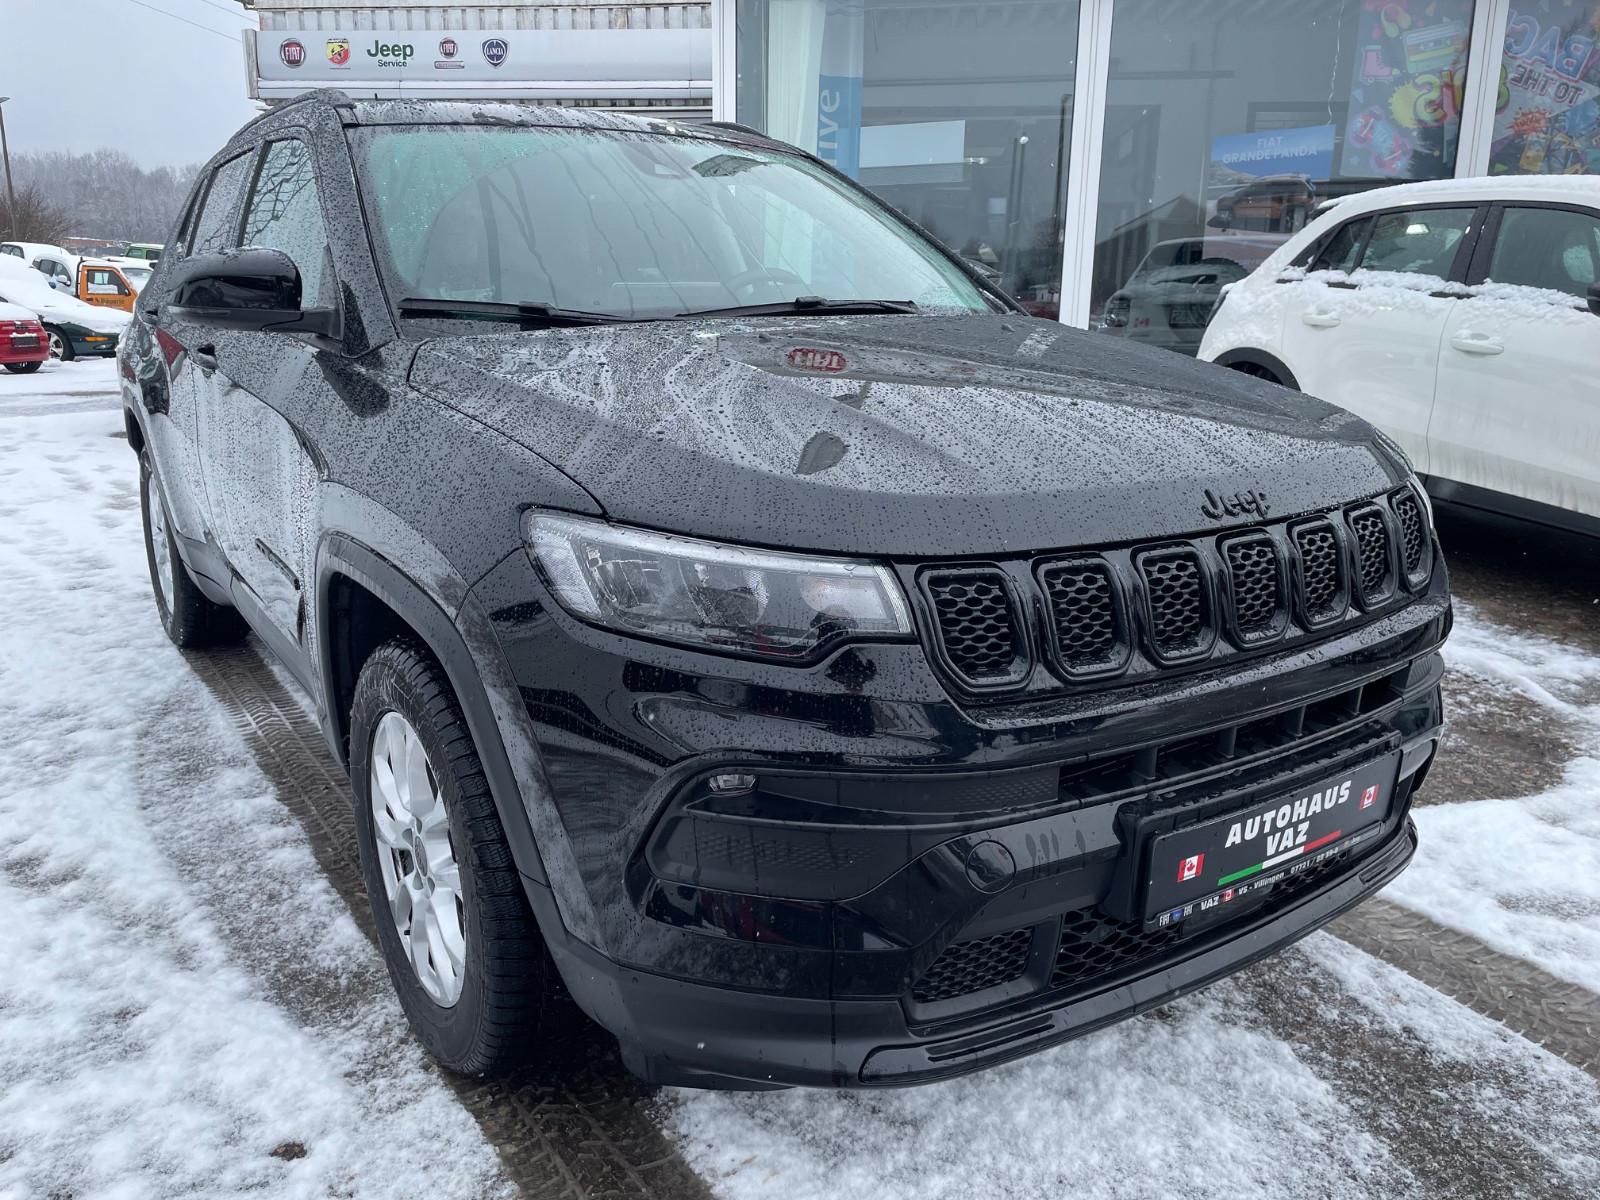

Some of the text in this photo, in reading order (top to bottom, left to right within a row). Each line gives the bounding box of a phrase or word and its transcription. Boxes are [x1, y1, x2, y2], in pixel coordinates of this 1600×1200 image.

[285, 47, 300, 61] FIAT
[367, 40, 414, 60] Jeep
[486, 47, 504, 56] LANCIA
[1257, 136, 1283, 149] FIAT
[1222, 145, 1318, 164] GRANDE PANDA
[1201, 488, 1271, 521] Jeep
[1224, 780, 1352, 848] AUTOHAUS
[1266, 821, 1310, 857] VAZ
[1200, 896, 1220, 910] VAZ
[1238, 885, 1249, 895] VS
[1254, 871, 1285, 889] Villingen
